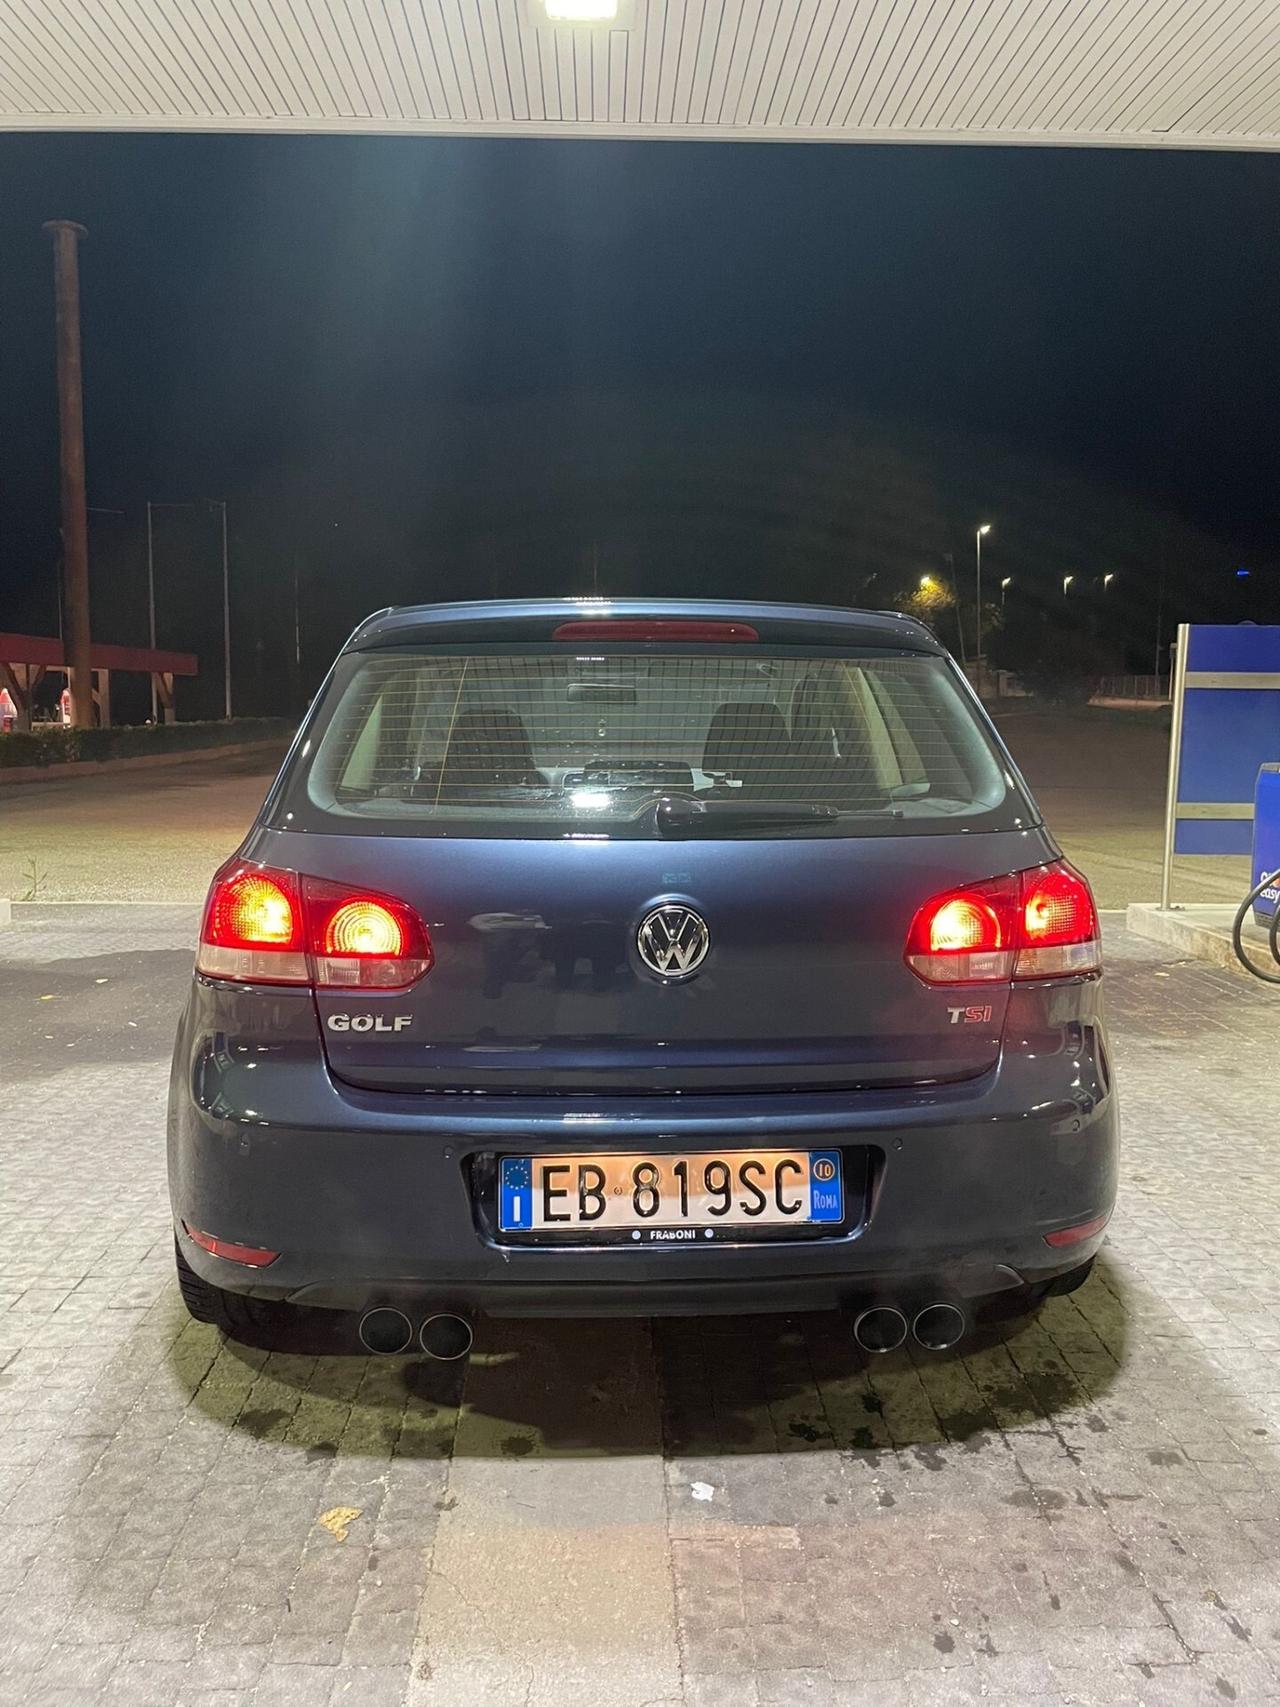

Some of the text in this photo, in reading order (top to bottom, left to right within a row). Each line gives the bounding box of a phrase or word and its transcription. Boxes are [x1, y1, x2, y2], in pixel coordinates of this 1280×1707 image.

[327, 1013, 413, 1032] GOLF
[947, 1005, 992, 1024] TSI
[818, 1163, 830, 1177] 10
[513, 1196, 521, 1222] I
[650, 1229, 696, 1240] FRABONI
